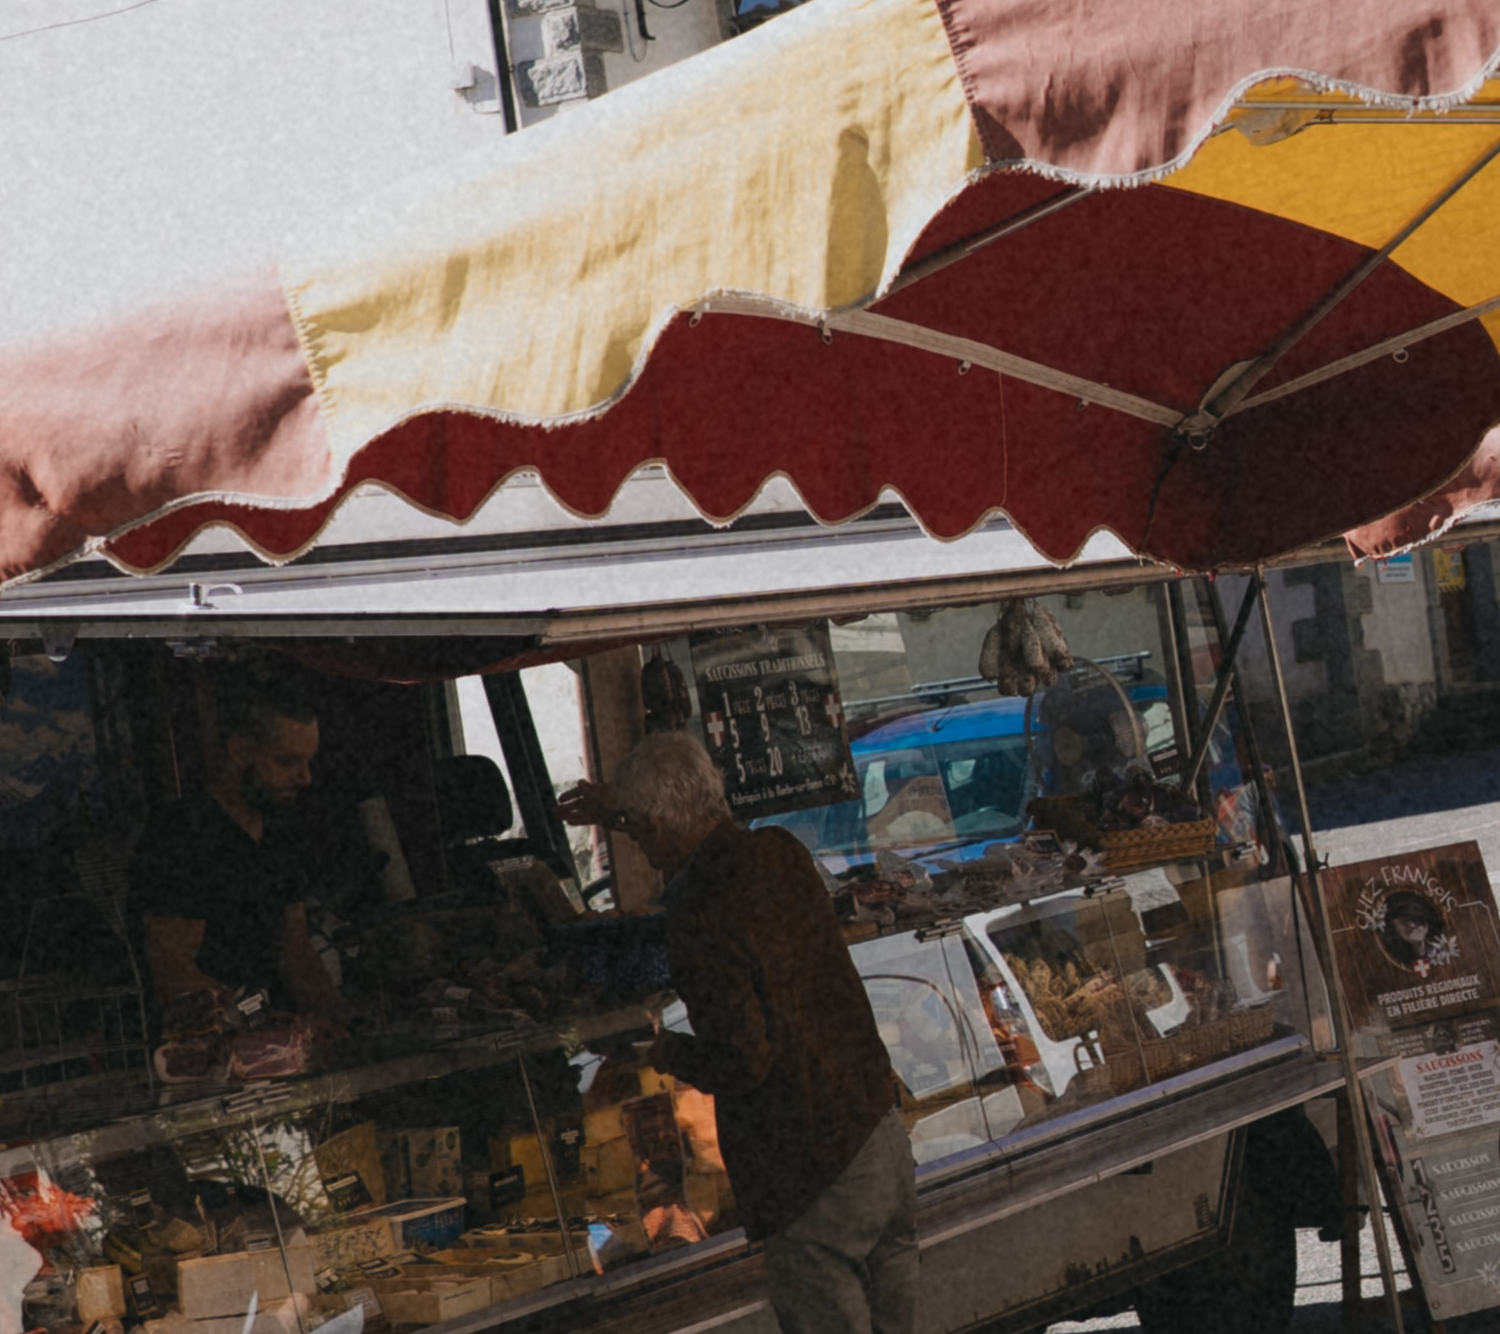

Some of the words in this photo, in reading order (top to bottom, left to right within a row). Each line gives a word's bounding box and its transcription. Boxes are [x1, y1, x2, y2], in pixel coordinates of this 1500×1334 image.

[753, 686, 765, 712] 2
[788, 680, 799, 706] 3
[729, 718, 740, 749] 5
[760, 712, 771, 742] 9
[795, 705, 812, 736] 13
[735, 752, 746, 783] 5
[766, 746, 784, 777] 20
[1355, 876, 1383, 930] CHEZ
[1377, 985, 1425, 1006] PRODUITS
[1425, 973, 1481, 994] RÉGIONAUX
[1386, 1005, 1400, 1017] EN
[1401, 995, 1440, 1017] FILIÈRE
[1440, 987, 1480, 1007] DIRECTE
[1415, 1049, 1484, 1074] SAUCISSONS
[1413, 1158, 1428, 1186] 1
[1429, 1217, 1445, 1245] 3
[1438, 1244, 1455, 1274] 5
